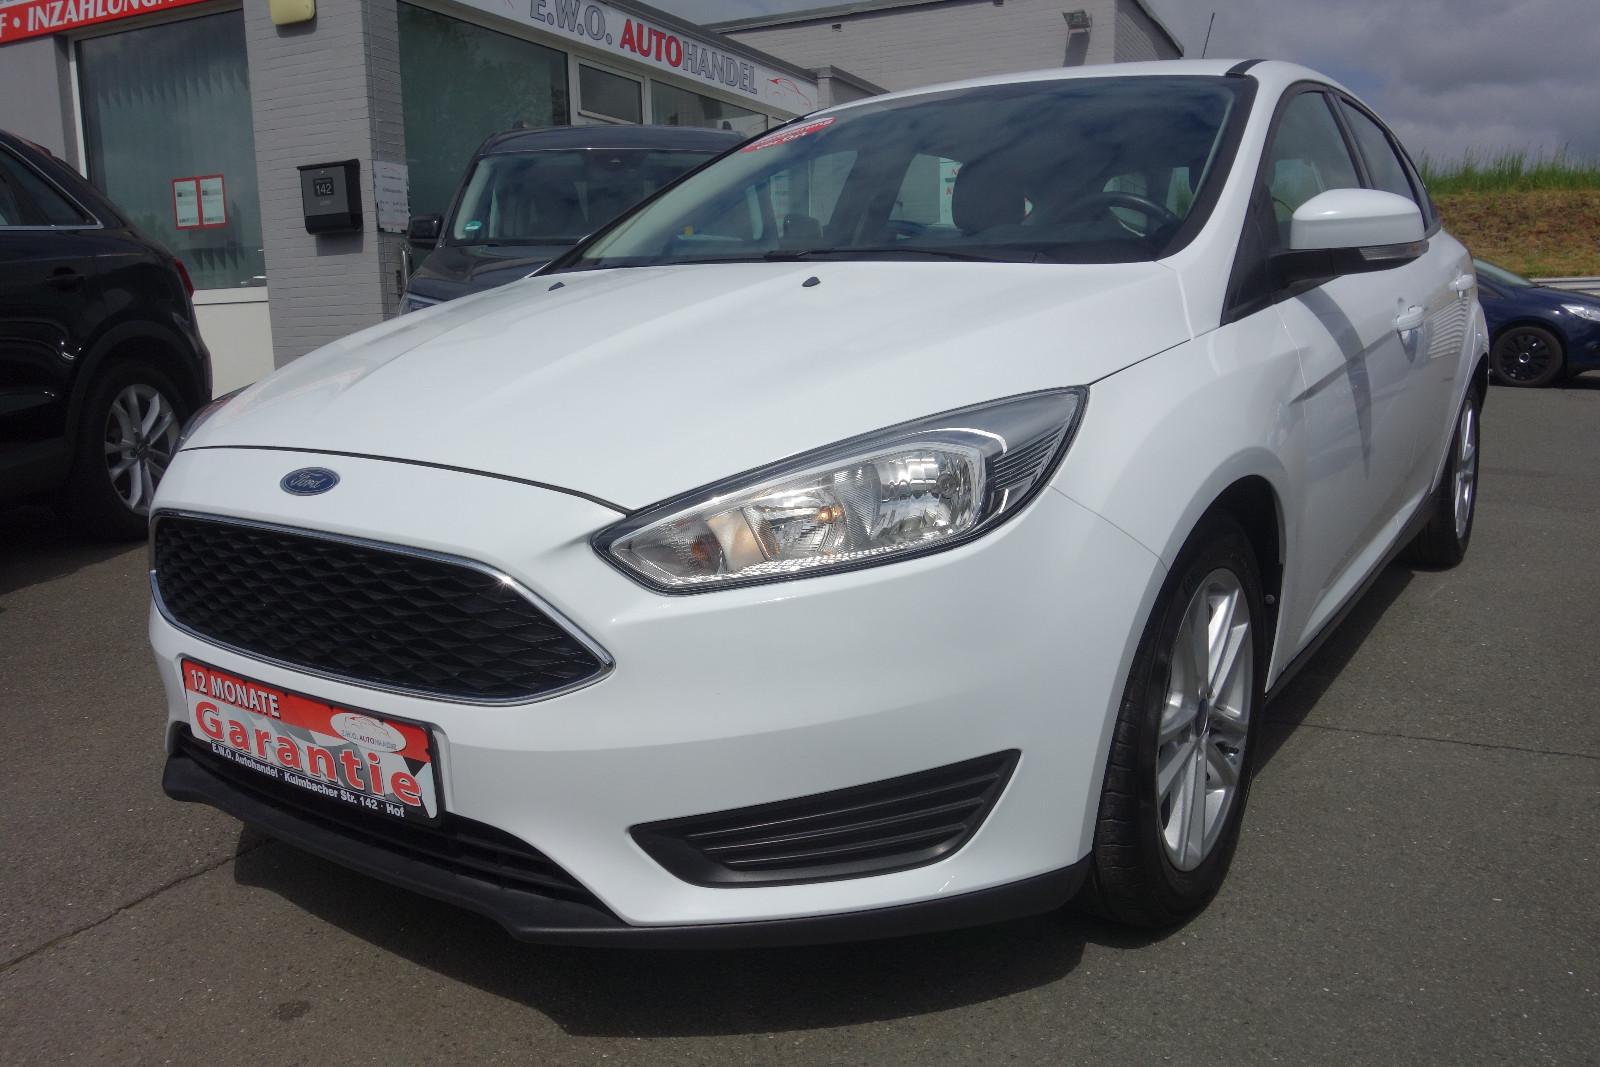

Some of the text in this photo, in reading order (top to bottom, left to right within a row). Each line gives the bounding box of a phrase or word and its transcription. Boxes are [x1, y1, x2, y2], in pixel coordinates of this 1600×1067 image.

[529, 0, 613, 45] E.W.O.
[316, 183, 332, 195] 142
[191, 669, 281, 718] 12 MONATE
[194, 700, 422, 808] Garantie
[235, 752, 279, 778] Autohandel
[284, 771, 339, 798] Kulmbacher
[340, 790, 357, 804] Str.
[359, 797, 378, 811] 142
